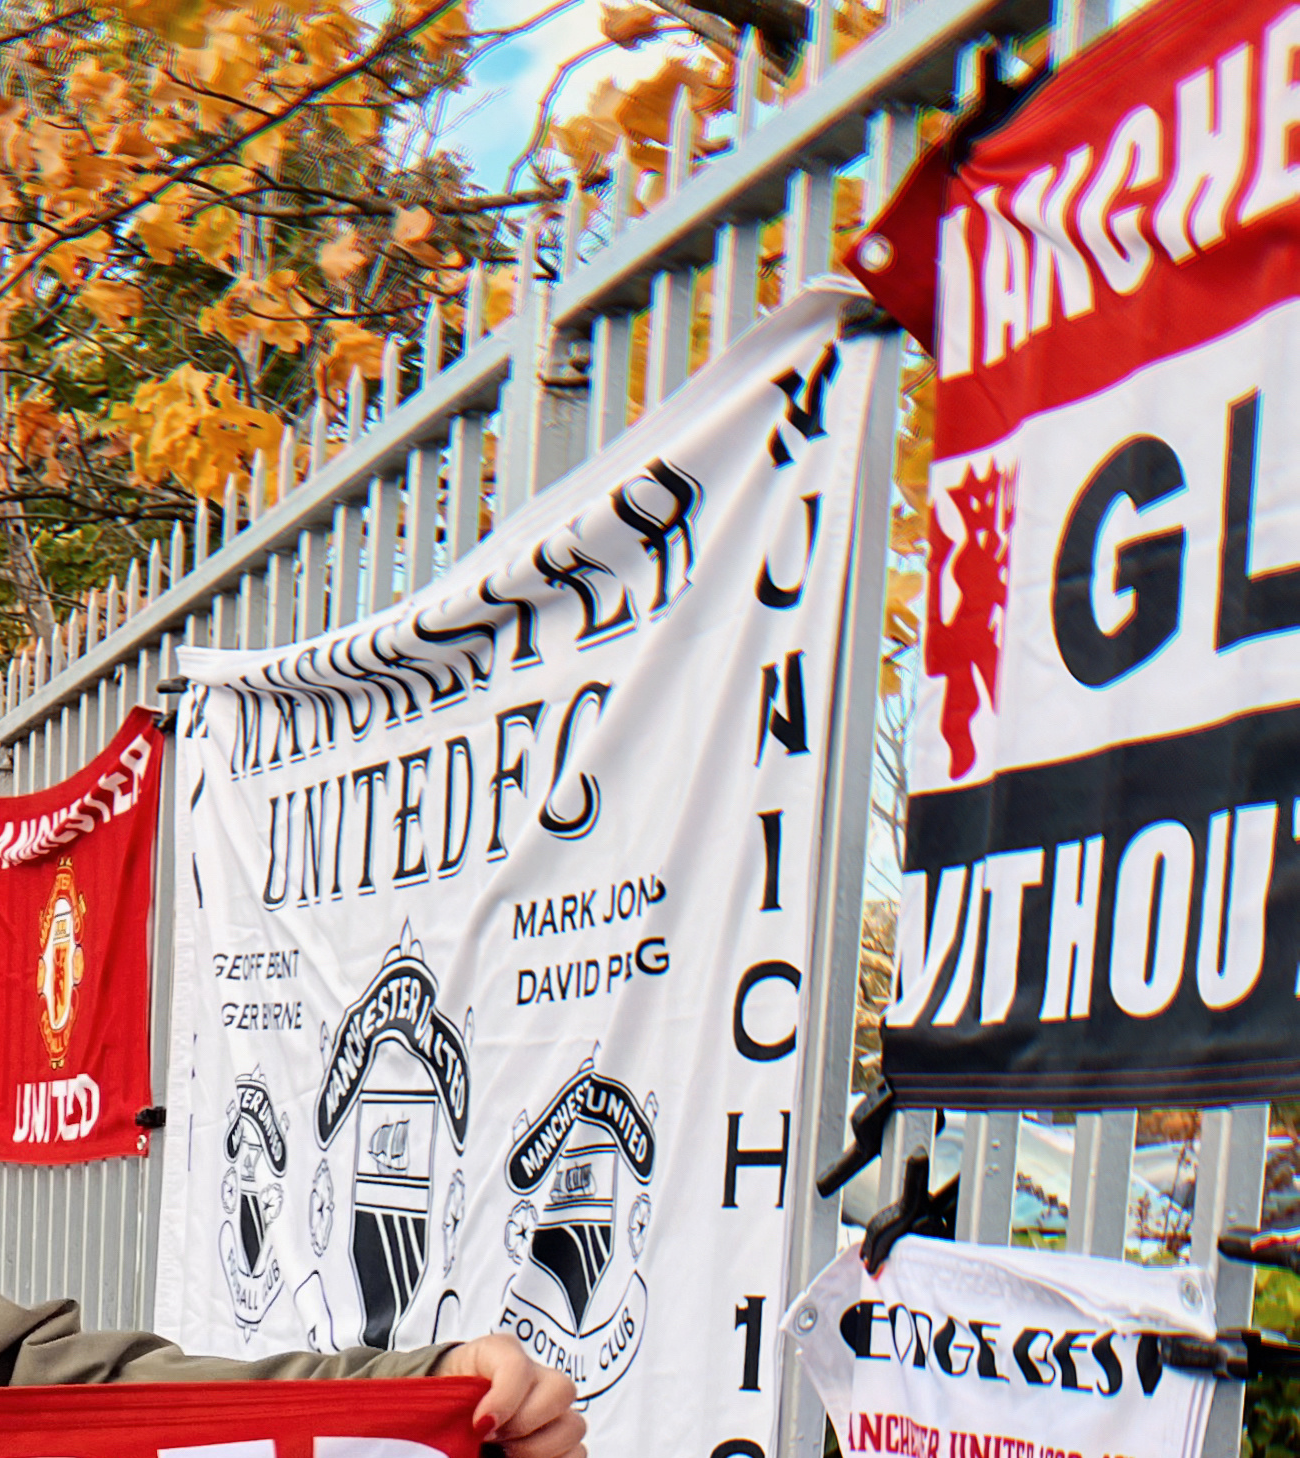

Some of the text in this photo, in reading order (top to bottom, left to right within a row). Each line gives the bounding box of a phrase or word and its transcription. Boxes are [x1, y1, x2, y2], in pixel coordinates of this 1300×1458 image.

[513, 889, 597, 940] MARK
[213, 949, 299, 980] GEOFF BENT
[517, 959, 600, 1006] DAVID
[326, 975, 422, 1125] MANCHESTER
[414, 995, 465, 1119] UNITED
[586, 1085, 647, 1163] UNITED
[499, 1306, 636, 1382] FOOTBALL CLUB
